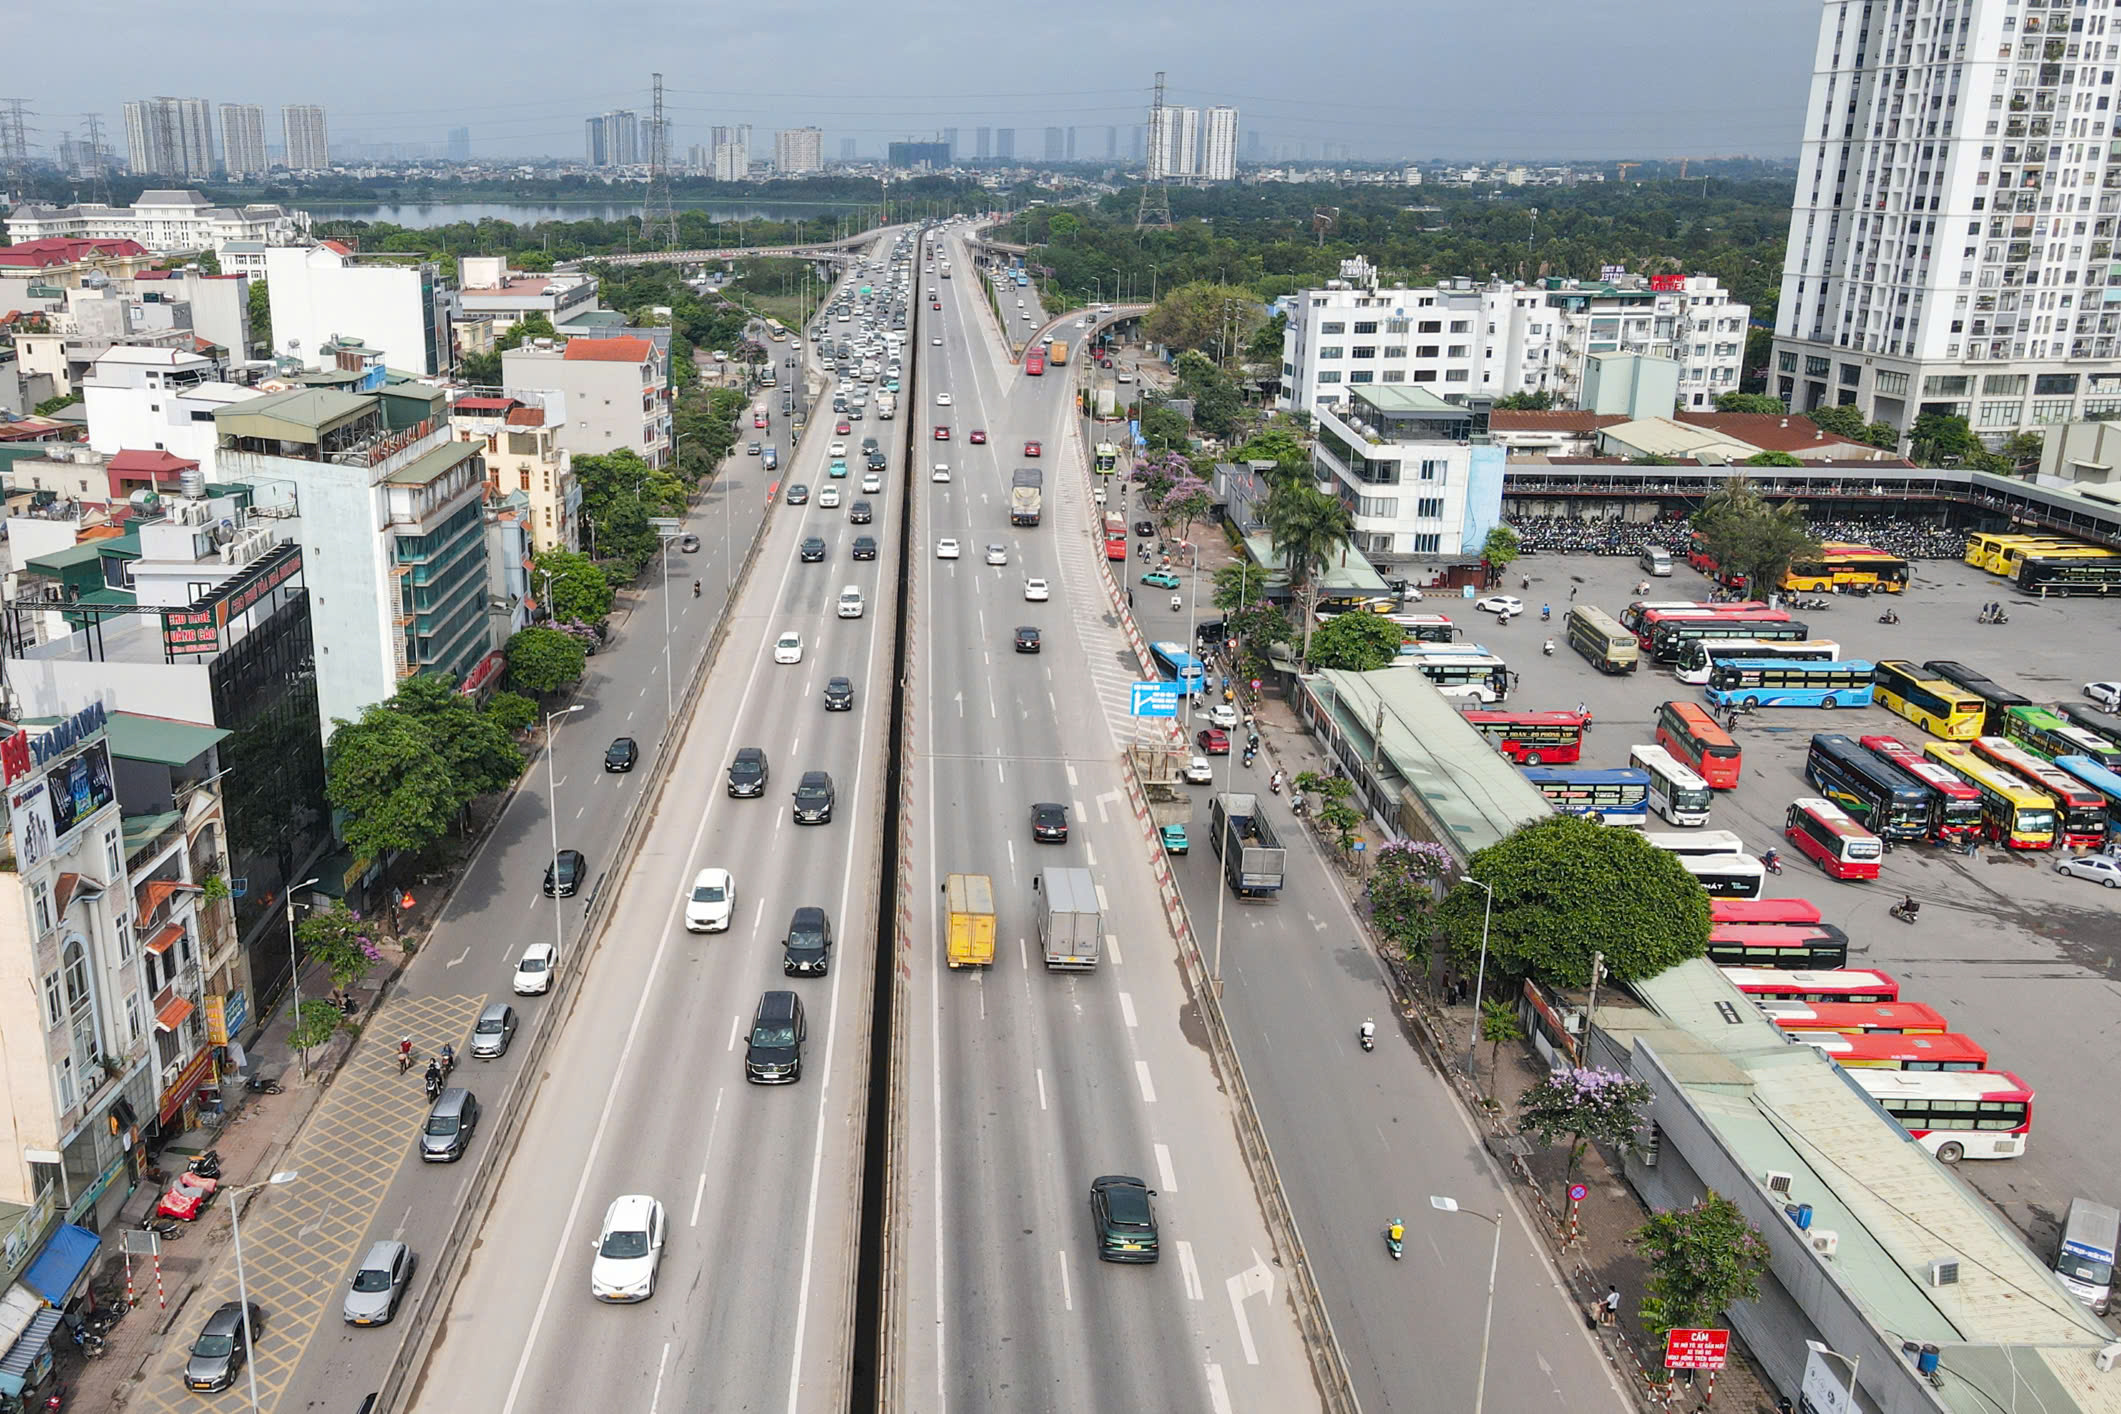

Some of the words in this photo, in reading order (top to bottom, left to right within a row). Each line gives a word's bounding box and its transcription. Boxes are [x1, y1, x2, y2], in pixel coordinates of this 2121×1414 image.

[197, 626, 217, 640] CÁO
[29, 699, 108, 766] YAMAWA
[1691, 1330, 1709, 1341] CẤM
